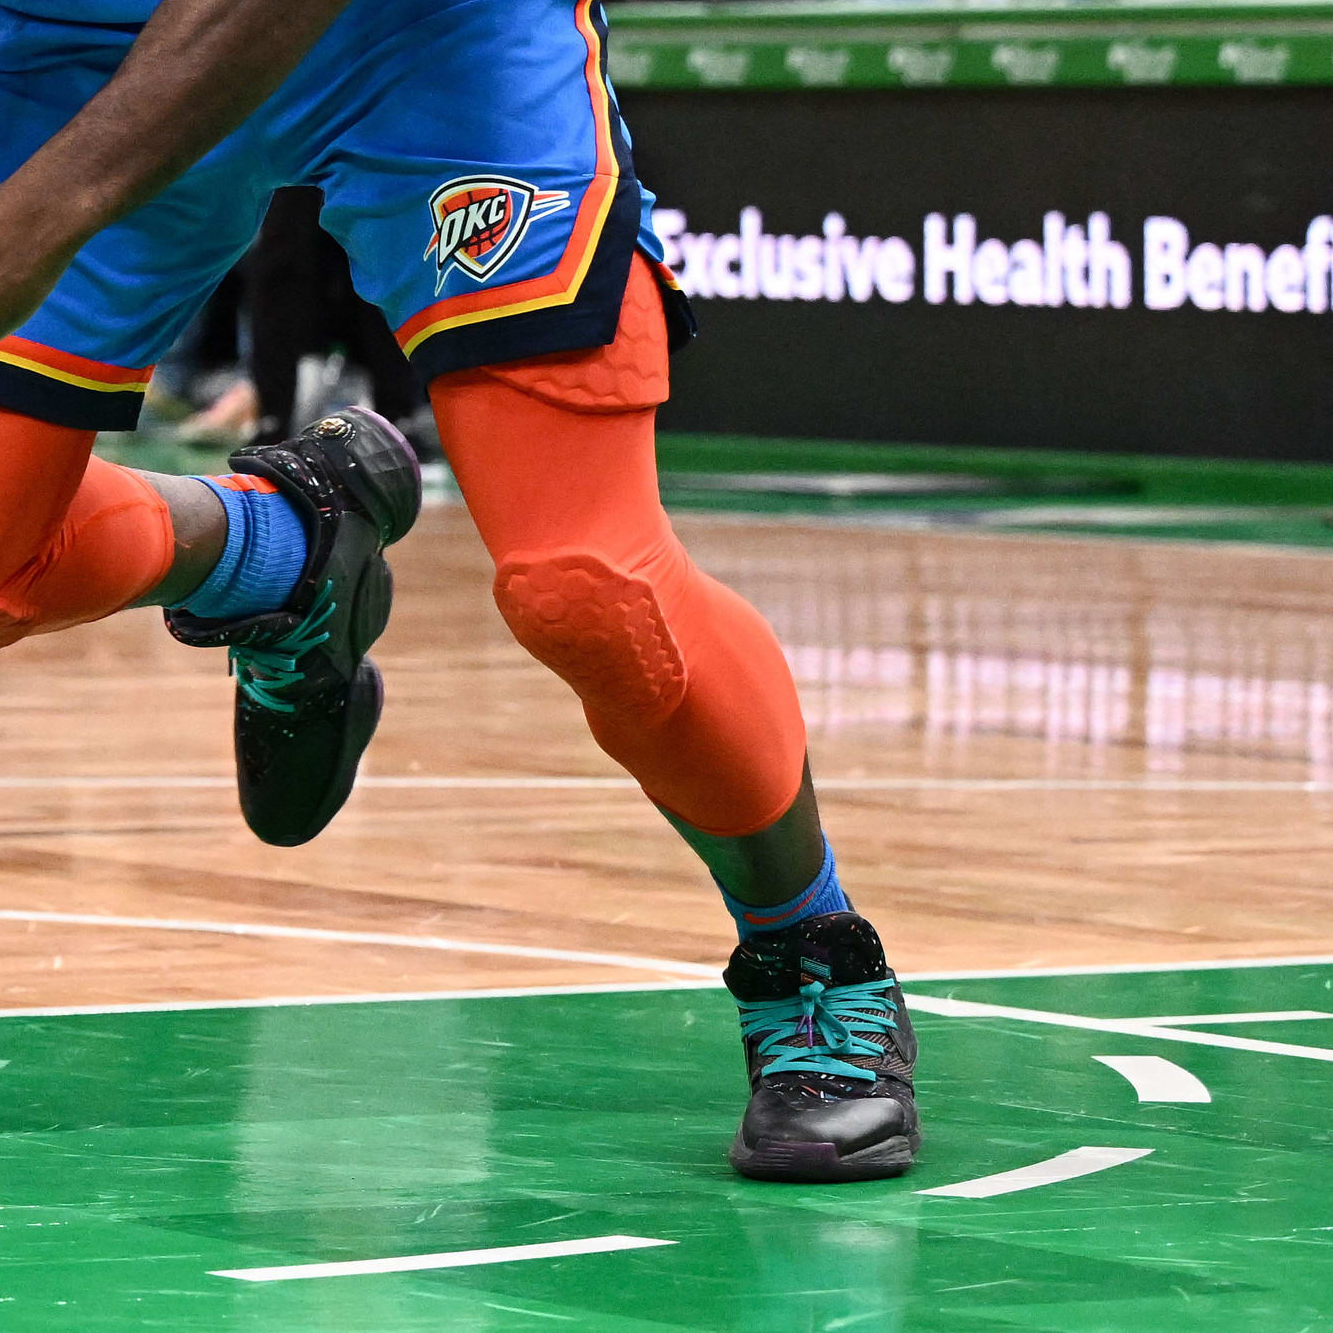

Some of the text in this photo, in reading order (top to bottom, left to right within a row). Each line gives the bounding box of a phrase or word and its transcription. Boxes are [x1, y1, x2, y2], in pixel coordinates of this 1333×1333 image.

[438, 193, 507, 266] OKC
[924, 211, 1132, 308] Health
[1144, 214, 1333, 313] Benef
